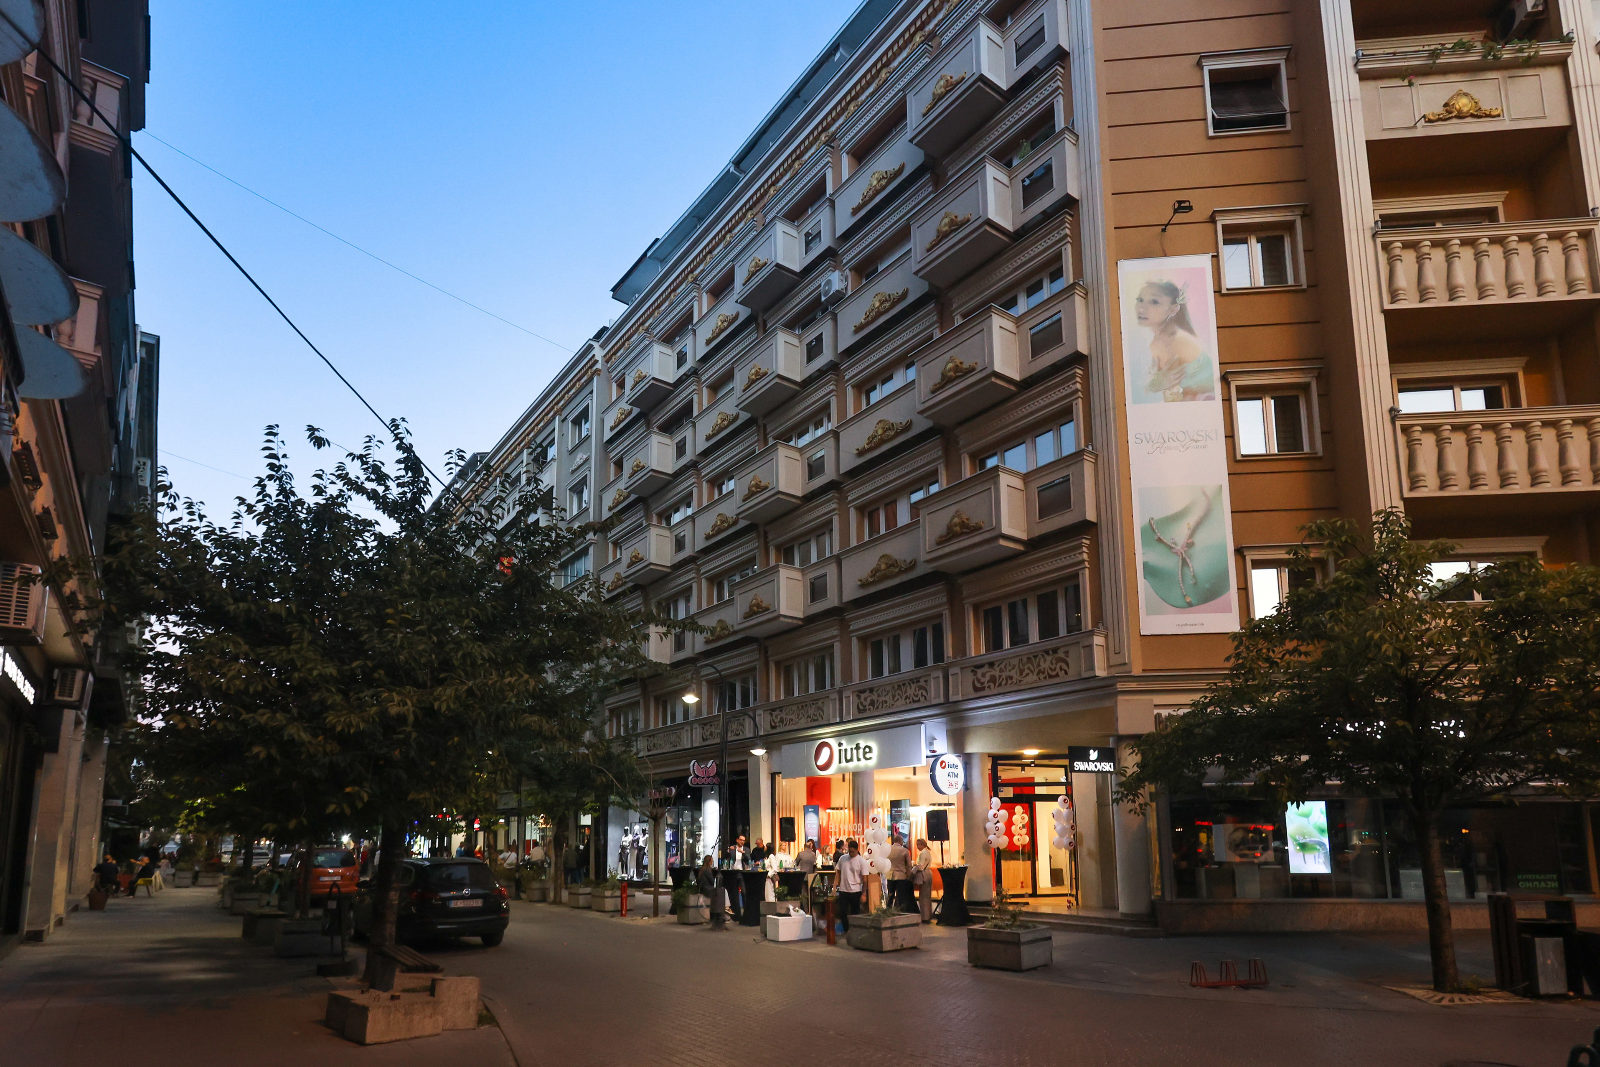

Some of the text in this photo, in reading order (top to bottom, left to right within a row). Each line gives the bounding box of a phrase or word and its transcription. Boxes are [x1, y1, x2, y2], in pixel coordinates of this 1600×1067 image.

[1134, 428, 1218, 445] SWAROVSKI
[837, 742, 873, 765] iute
[947, 761, 959, 769] iute
[1074, 761, 1114, 771] SWAROVSKI
[947, 771, 959, 779] ATM
